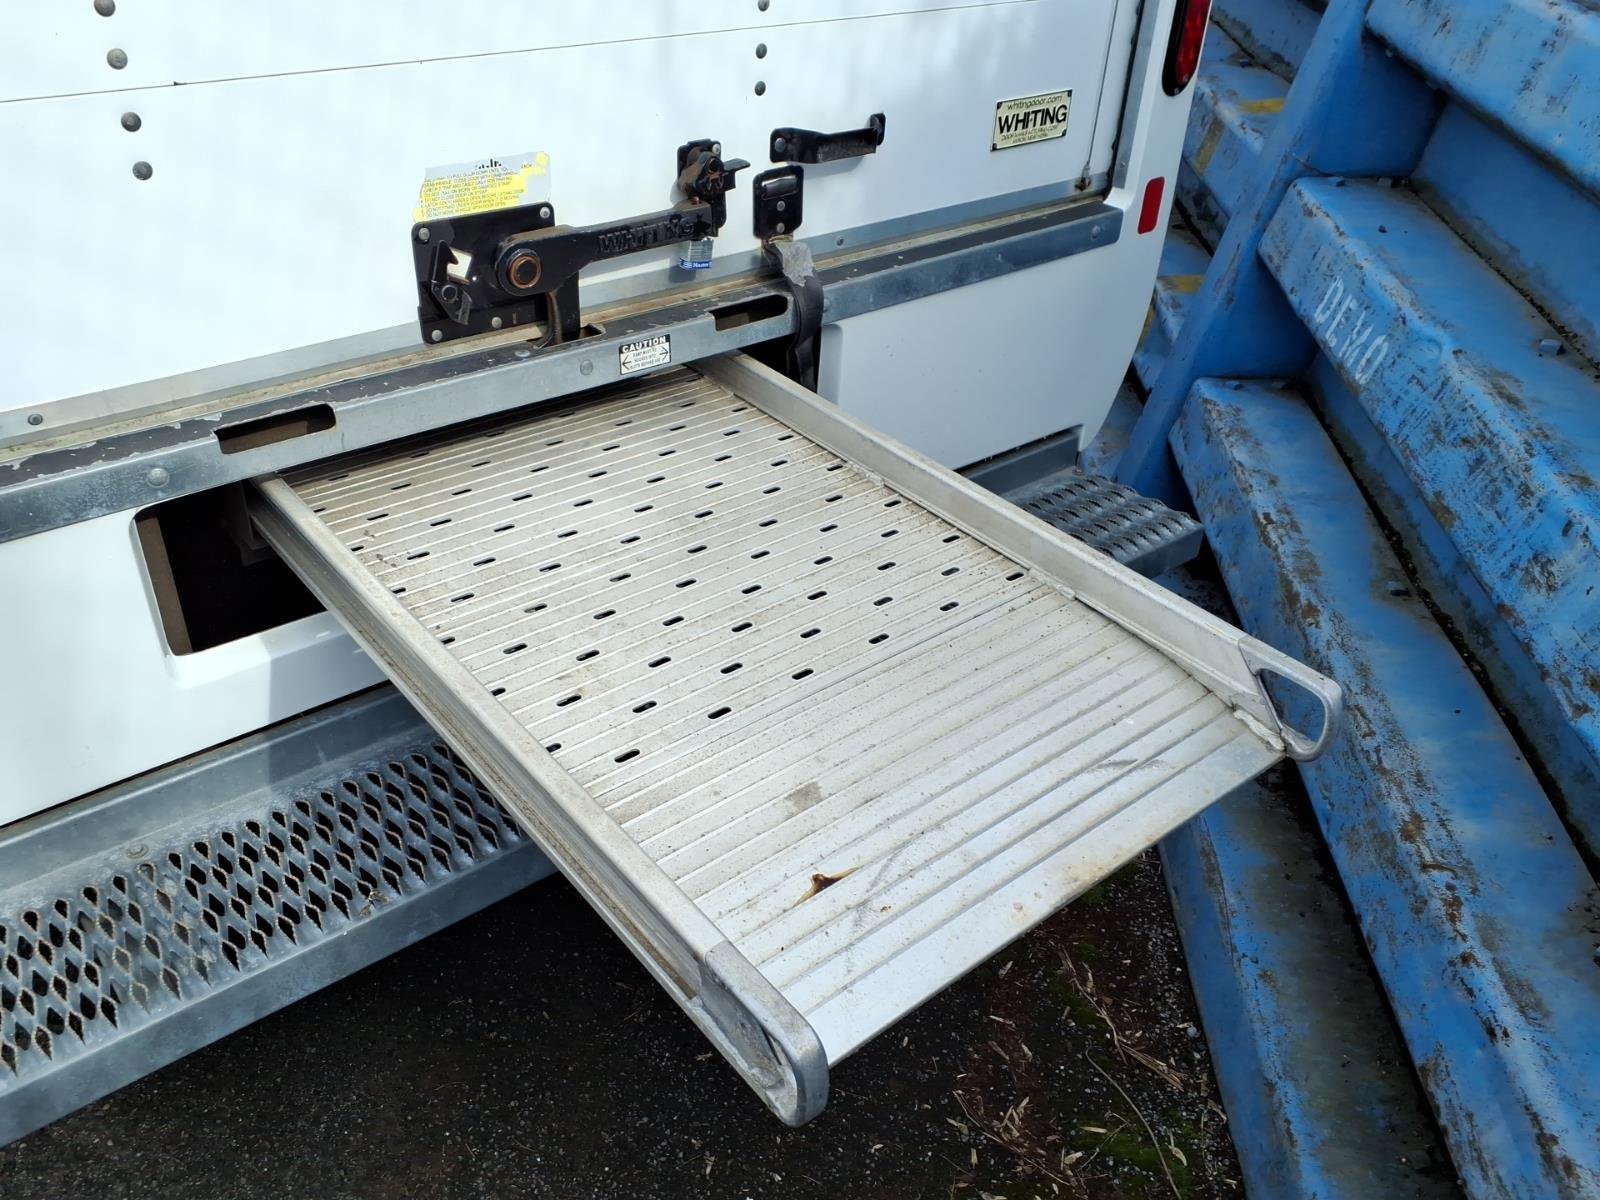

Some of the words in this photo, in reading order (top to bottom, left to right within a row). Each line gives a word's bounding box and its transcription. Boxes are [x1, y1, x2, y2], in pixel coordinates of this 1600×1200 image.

[1007, 95, 1063, 110] whitingdoor.com
[998, 104, 1068, 134] WHITING
[1313, 275, 1390, 385] DEMO
[622, 335, 666, 353] CAUTION
